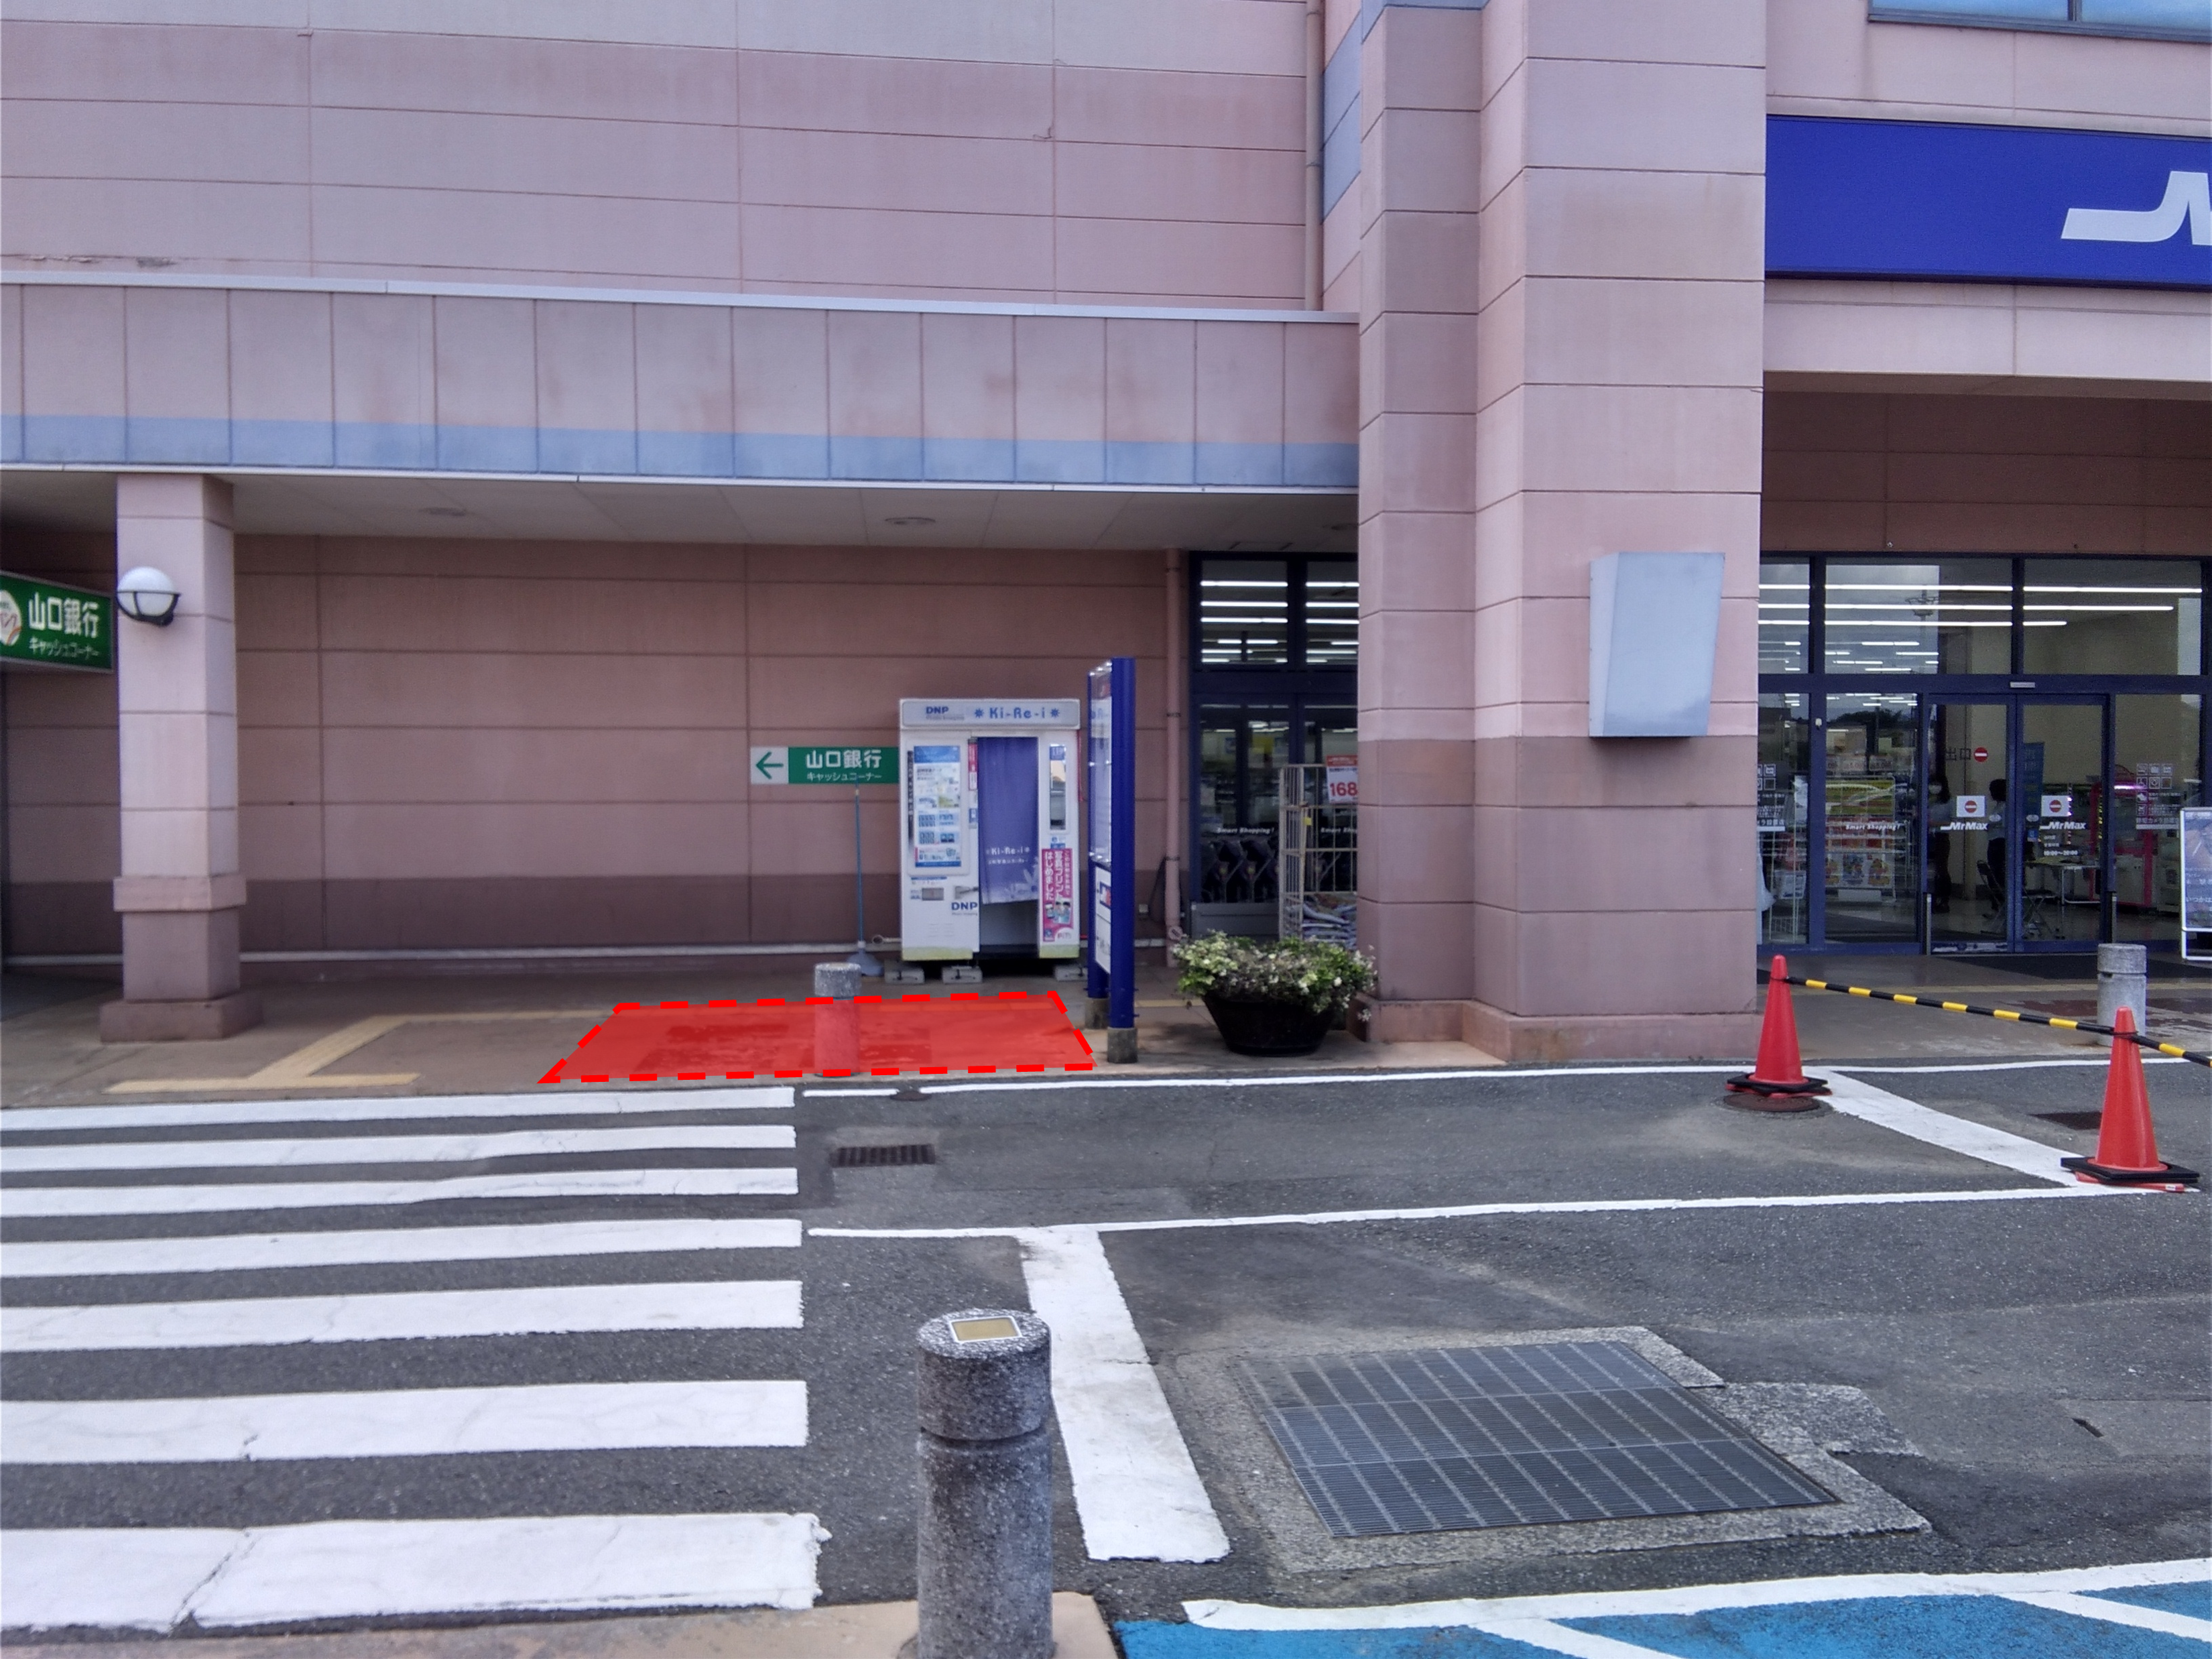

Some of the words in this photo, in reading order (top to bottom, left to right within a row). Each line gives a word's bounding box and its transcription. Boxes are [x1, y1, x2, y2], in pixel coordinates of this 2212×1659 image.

[28, 592, 99, 638] 山口銀行
[29, 635, 99, 660] キャッシュコーナー
[926, 706, 949, 714] DNP
[806, 749, 882, 768] 山口銀行
[1946, 747, 1971, 761] 出口
[806, 772, 882, 781] キャッシュコーナー
[1329, 782, 1358, 796] 168
[1940, 822, 1989, 831] MrMax
[2039, 821, 2087, 830] MrMax
[951, 902, 978, 910] DNP
